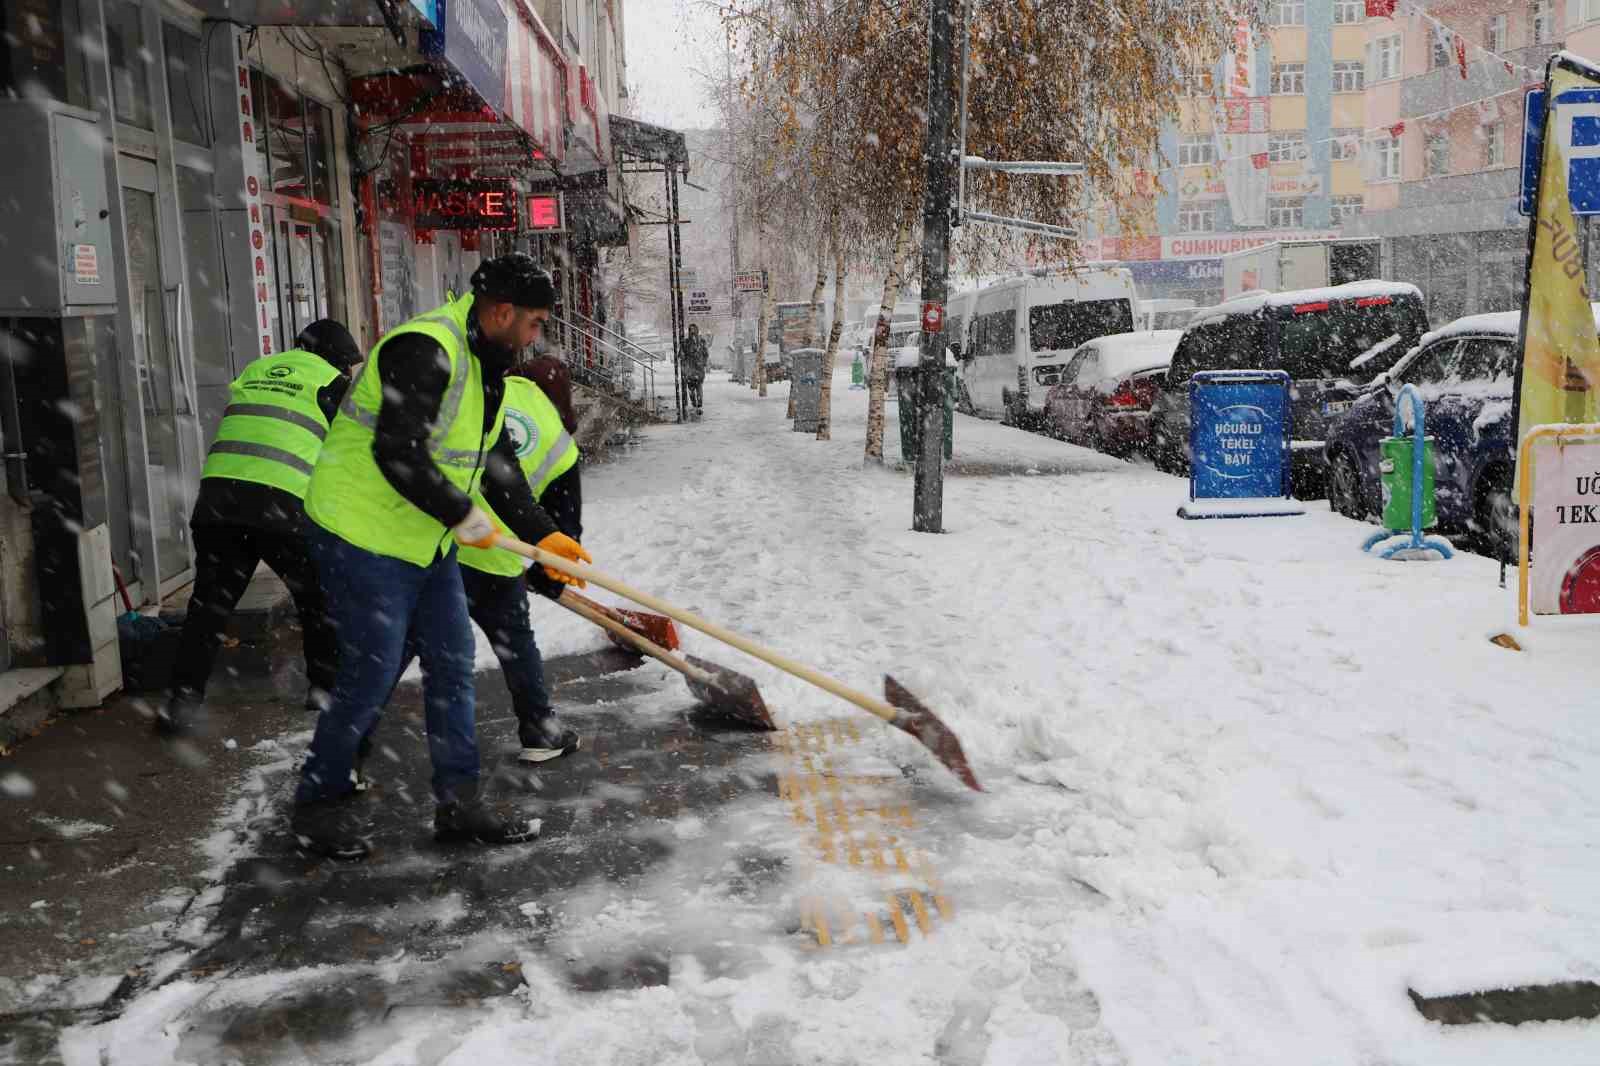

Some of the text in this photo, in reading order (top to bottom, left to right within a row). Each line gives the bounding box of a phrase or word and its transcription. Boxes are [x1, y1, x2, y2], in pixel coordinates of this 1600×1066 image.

[1172, 237, 1265, 256] CUMHURİYE
[1220, 438, 1256, 450] TEKEL
[1556, 505, 1600, 524] TEK
